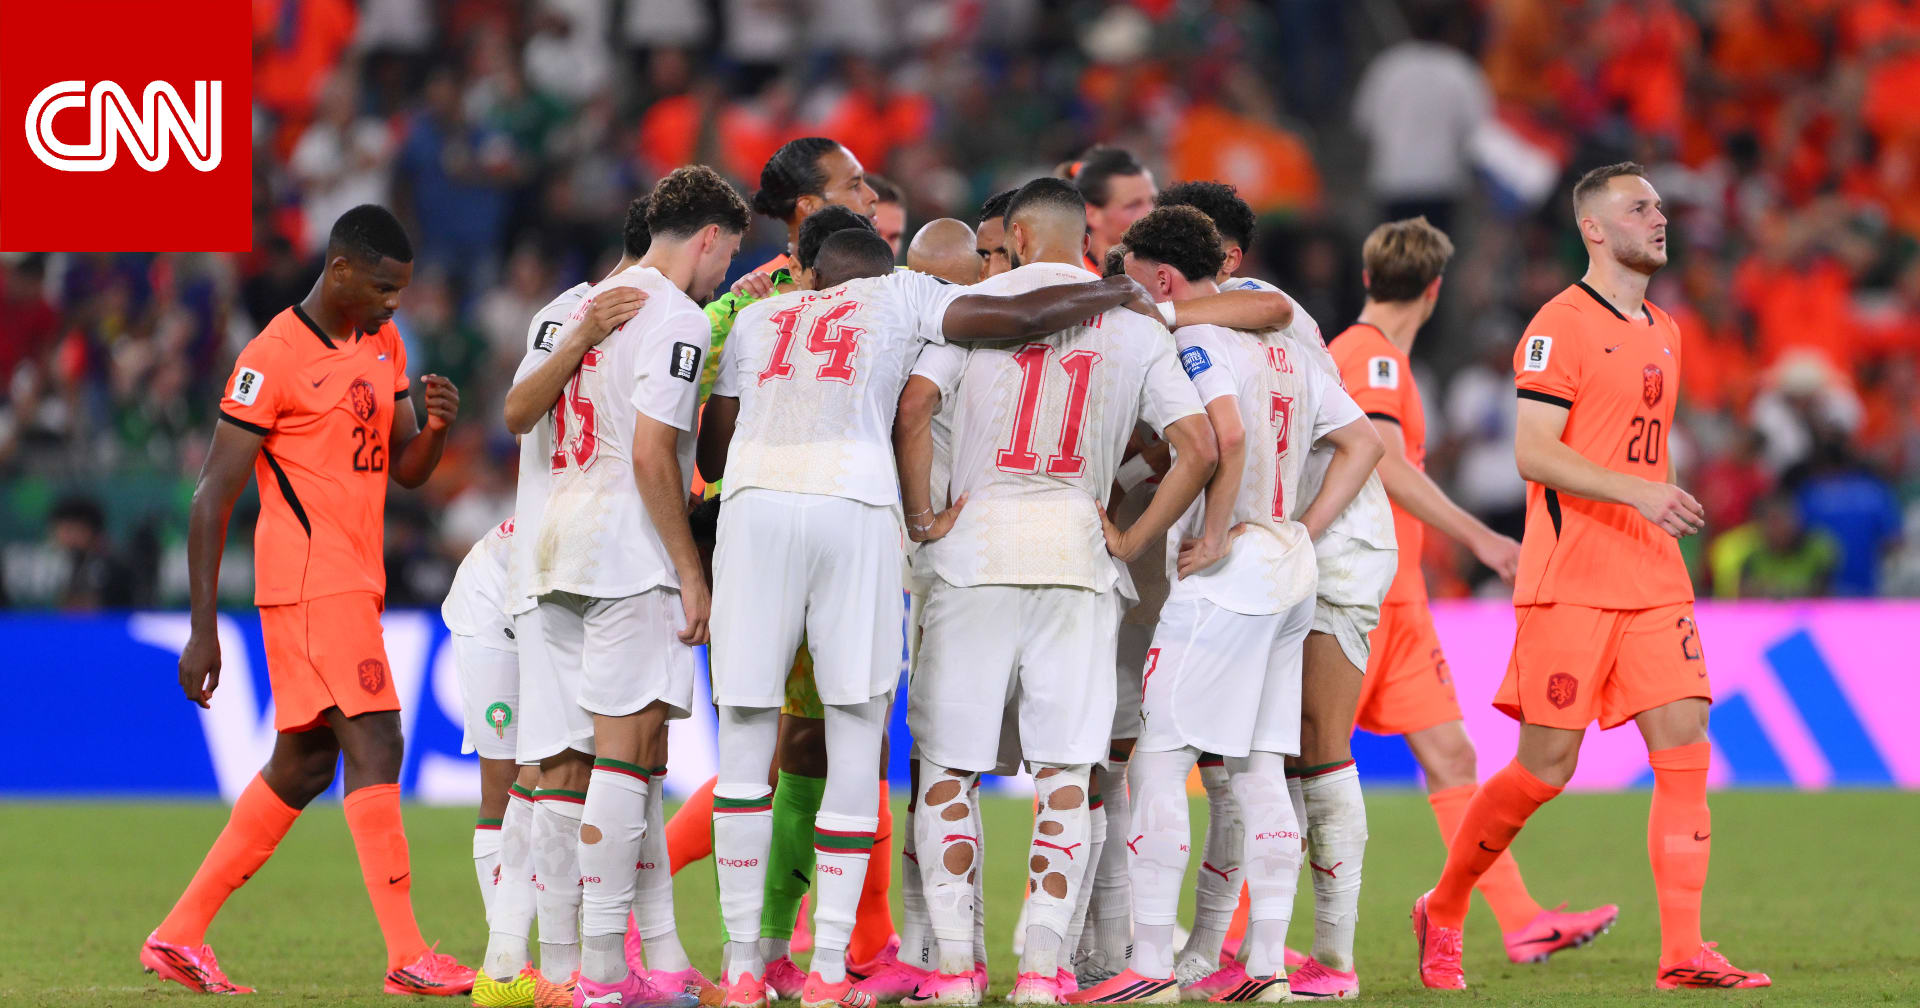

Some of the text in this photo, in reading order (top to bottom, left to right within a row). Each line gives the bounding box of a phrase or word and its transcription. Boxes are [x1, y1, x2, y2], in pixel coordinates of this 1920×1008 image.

[758, 301, 867, 388] 14
[550, 347, 604, 474] 15
[996, 342, 1104, 478] 11
[1626, 416, 1661, 464] 20
[351, 426, 385, 472] 22
[1269, 390, 1295, 524] 7
[1142, 647, 1162, 703] 7
[1661, 968, 1748, 988] F50
